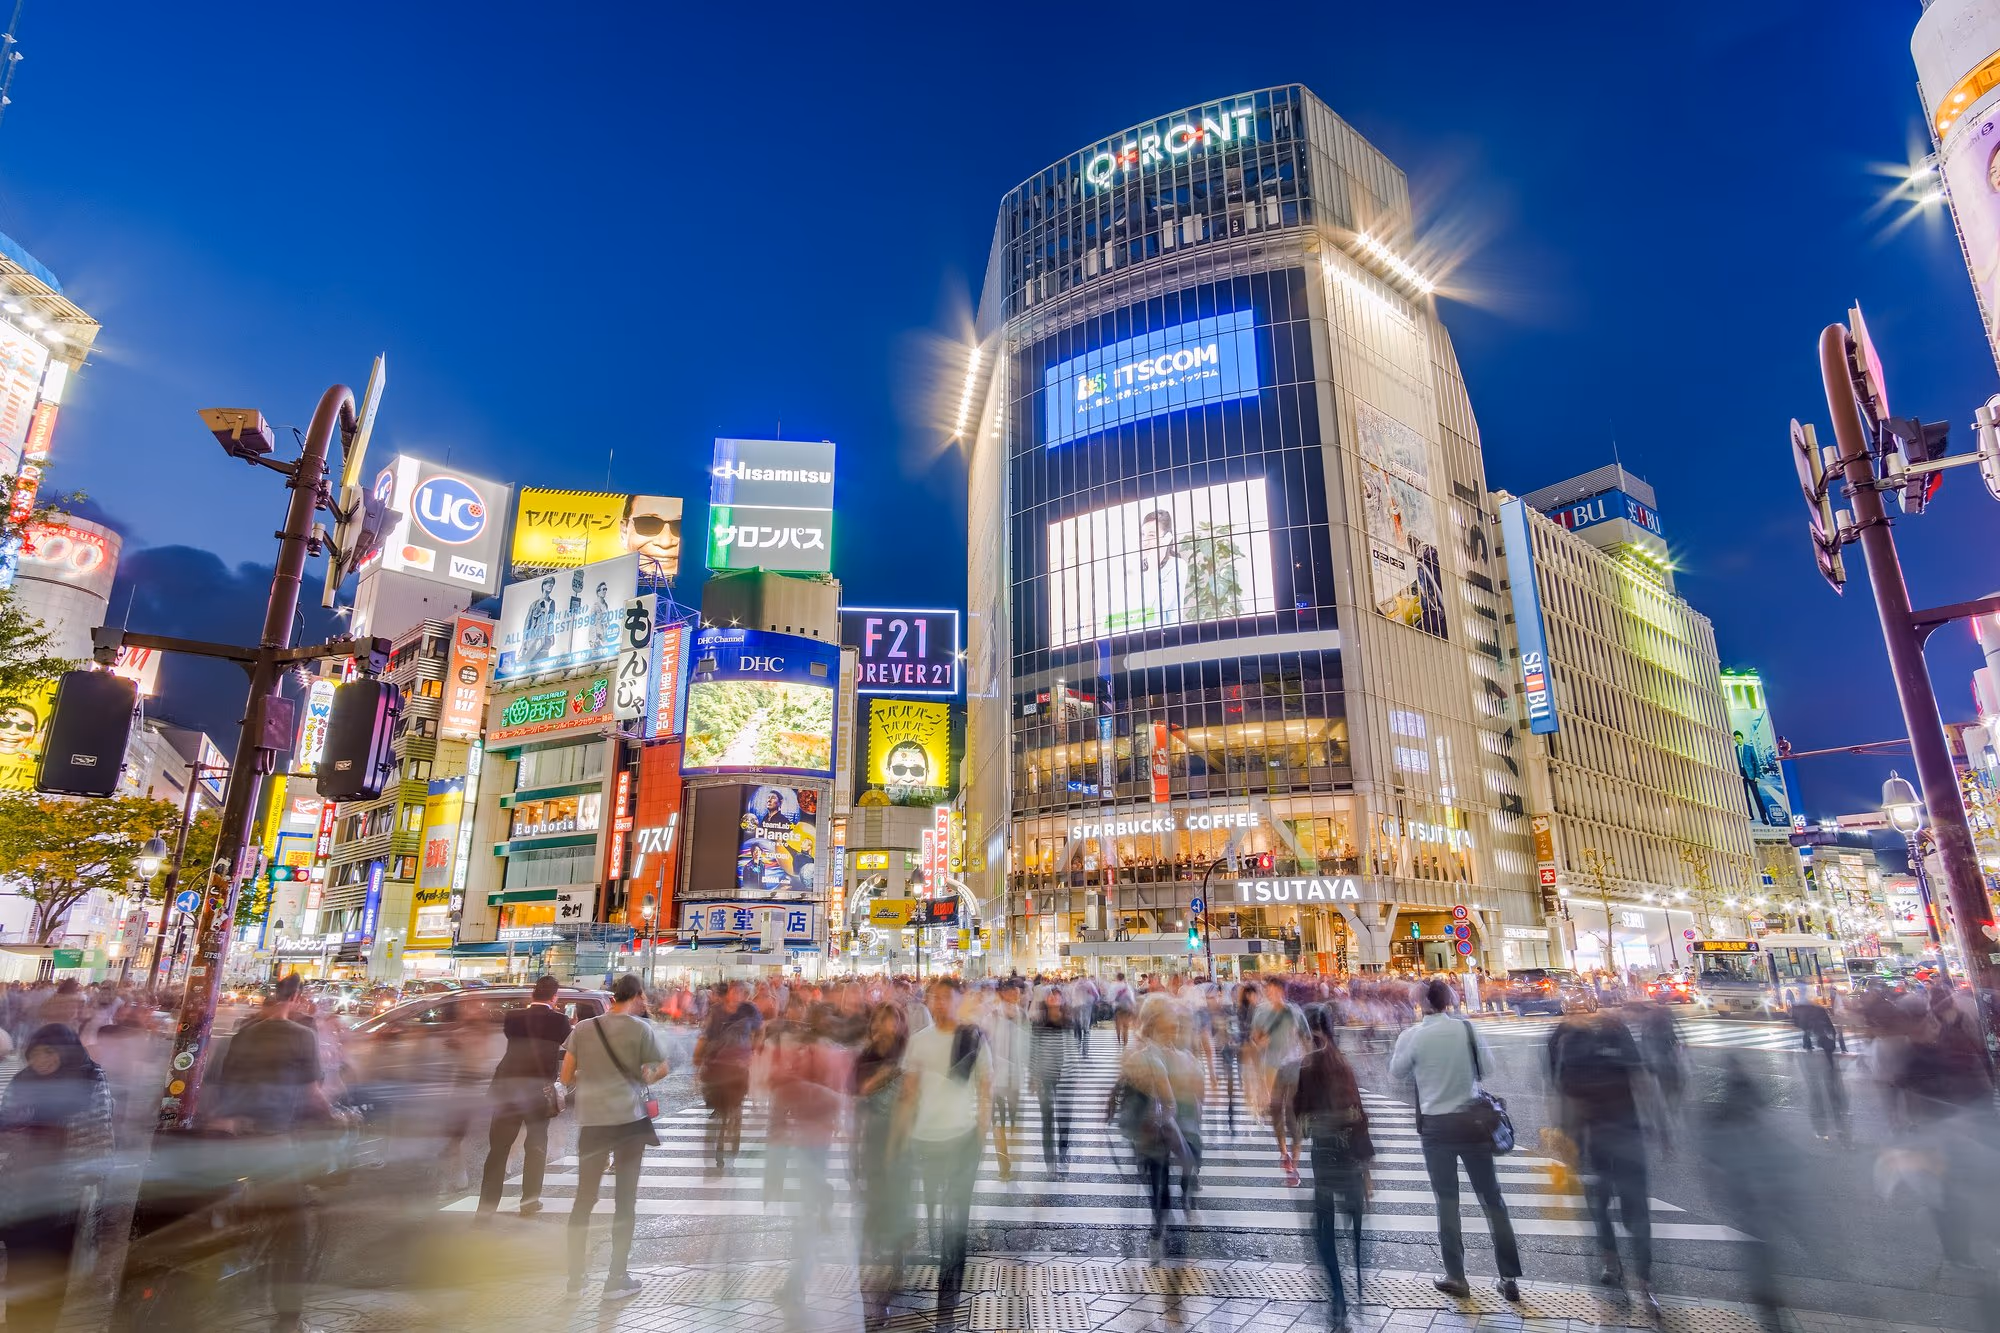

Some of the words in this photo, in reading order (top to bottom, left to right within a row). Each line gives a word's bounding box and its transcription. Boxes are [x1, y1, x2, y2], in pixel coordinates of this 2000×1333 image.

[713, 461, 832, 483] Hisamitsu
[525, 510, 617, 530] ヤバババーン
[1560, 499, 1607, 530] IBU
[1627, 499, 1662, 535] SEIBU
[714, 525, 824, 550] サロンパス
[454, 562, 485, 579] VISA
[505, 632, 521, 646] ALL
[548, 620, 572, 637] BEST
[714, 635, 745, 644] Channel
[865, 618, 927, 658] F21
[615, 600, 652, 714] もんじゃ
[739, 656, 785, 672] DHC
[656, 632, 678, 730] 三千里薬品
[857, 663, 927, 685] OREVER
[932, 664, 951, 685] 21
[1522, 651, 1550, 719] SEIBU
[530, 699, 567, 722] 西村
[874, 705, 944, 726] ヤバババーン
[881, 720, 936, 738] ヤバババーン
[515, 819, 575, 837] Euphoria
[755, 827, 801, 842] Planets
[762, 821, 790, 830] teamLab
[1073, 816, 1176, 840] STARBUCKS
[1186, 811, 1259, 831] COFFEE
[633, 812, 678, 879] クスリ
[937, 814, 948, 863] カラオケ
[1542, 870, 1555, 882] 本
[1238, 879, 1359, 902] TSUTAYA
[689, 908, 807, 932] 大盛堂店
